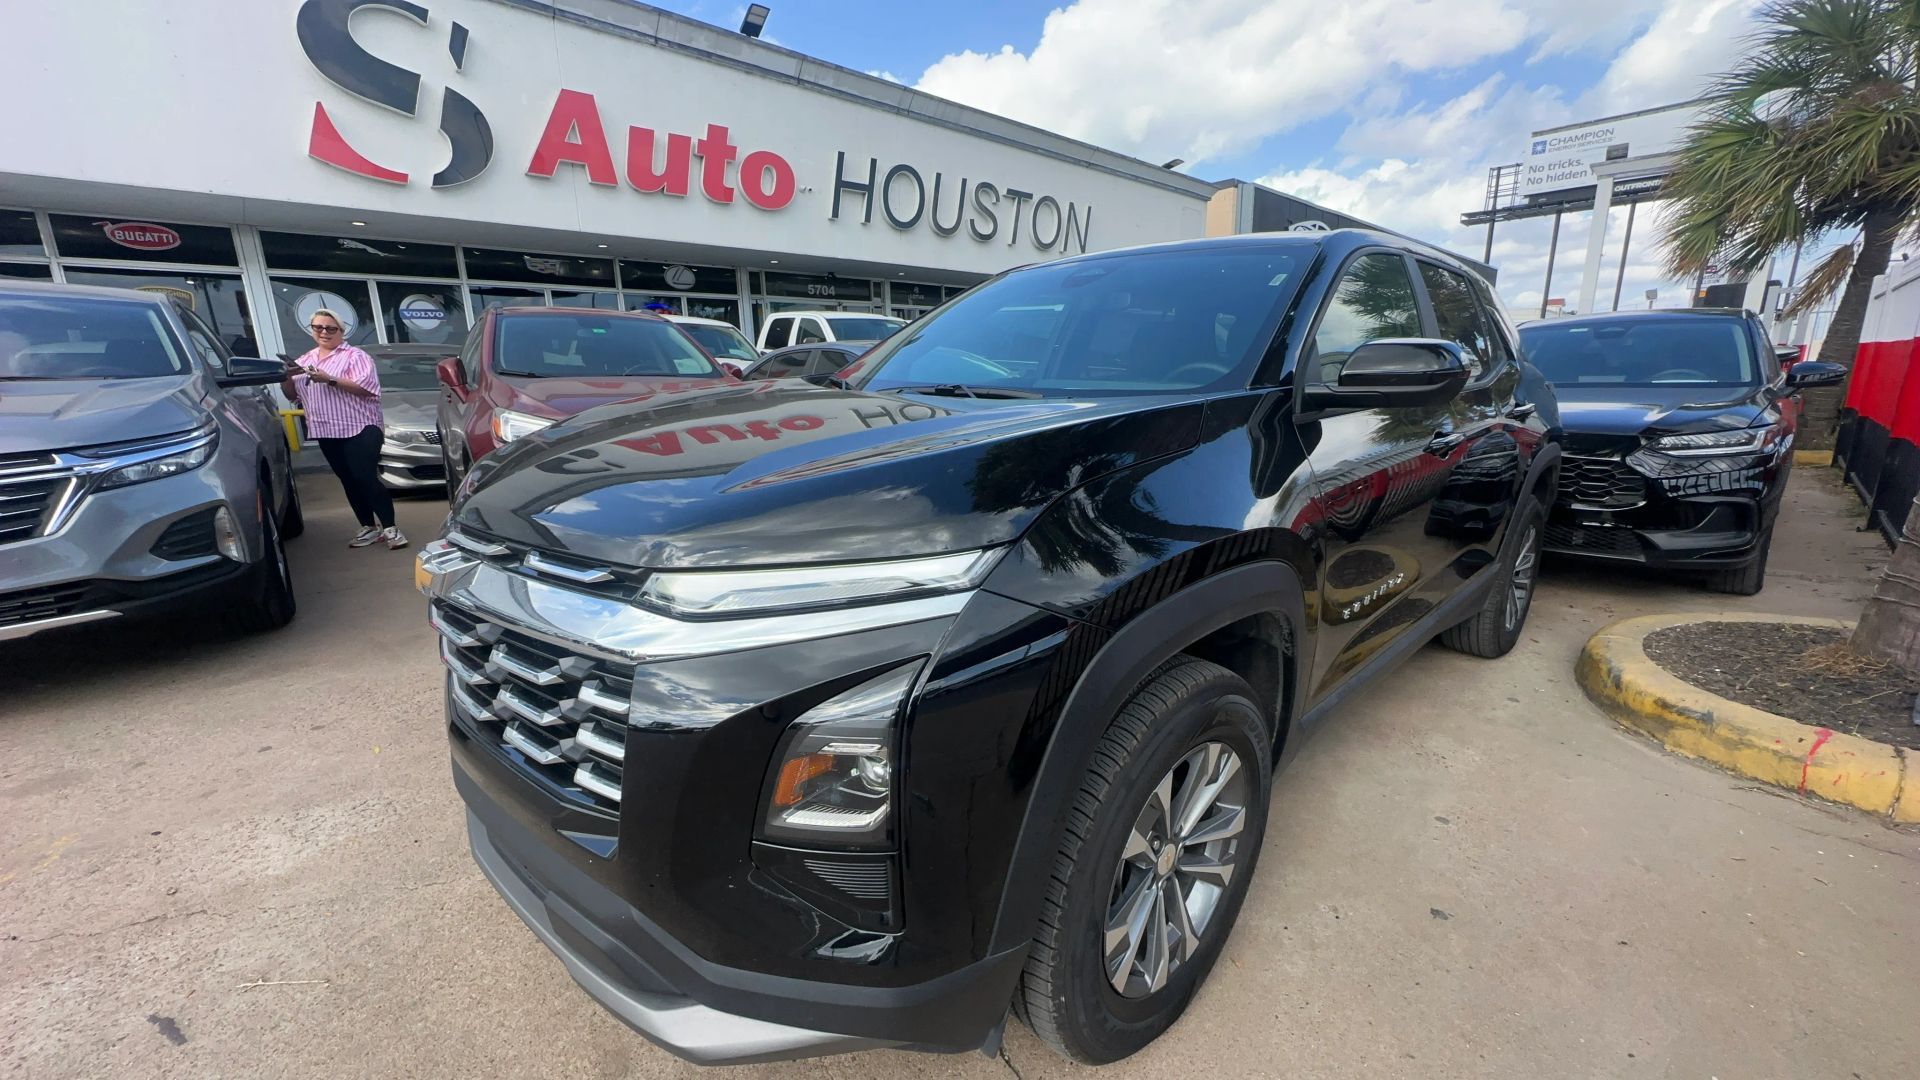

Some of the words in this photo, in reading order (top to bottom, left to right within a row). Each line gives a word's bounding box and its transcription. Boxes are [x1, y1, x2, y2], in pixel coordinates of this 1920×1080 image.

[1548, 128, 1615, 147] CHAMPION
[1548, 144, 1577, 153] ENERGY
[1577, 137, 1613, 150] SERVICES
[526, 88, 796, 211] Auto
[827, 150, 1092, 254] HOUSTON
[1528, 164, 1544, 174] No
[1548, 159, 1584, 171] tricks.
[1526, 177, 1543, 186] No
[1546, 169, 1588, 183] hidden
[114, 229, 174, 243] BUGATTI
[807, 284, 836, 297] 5704
